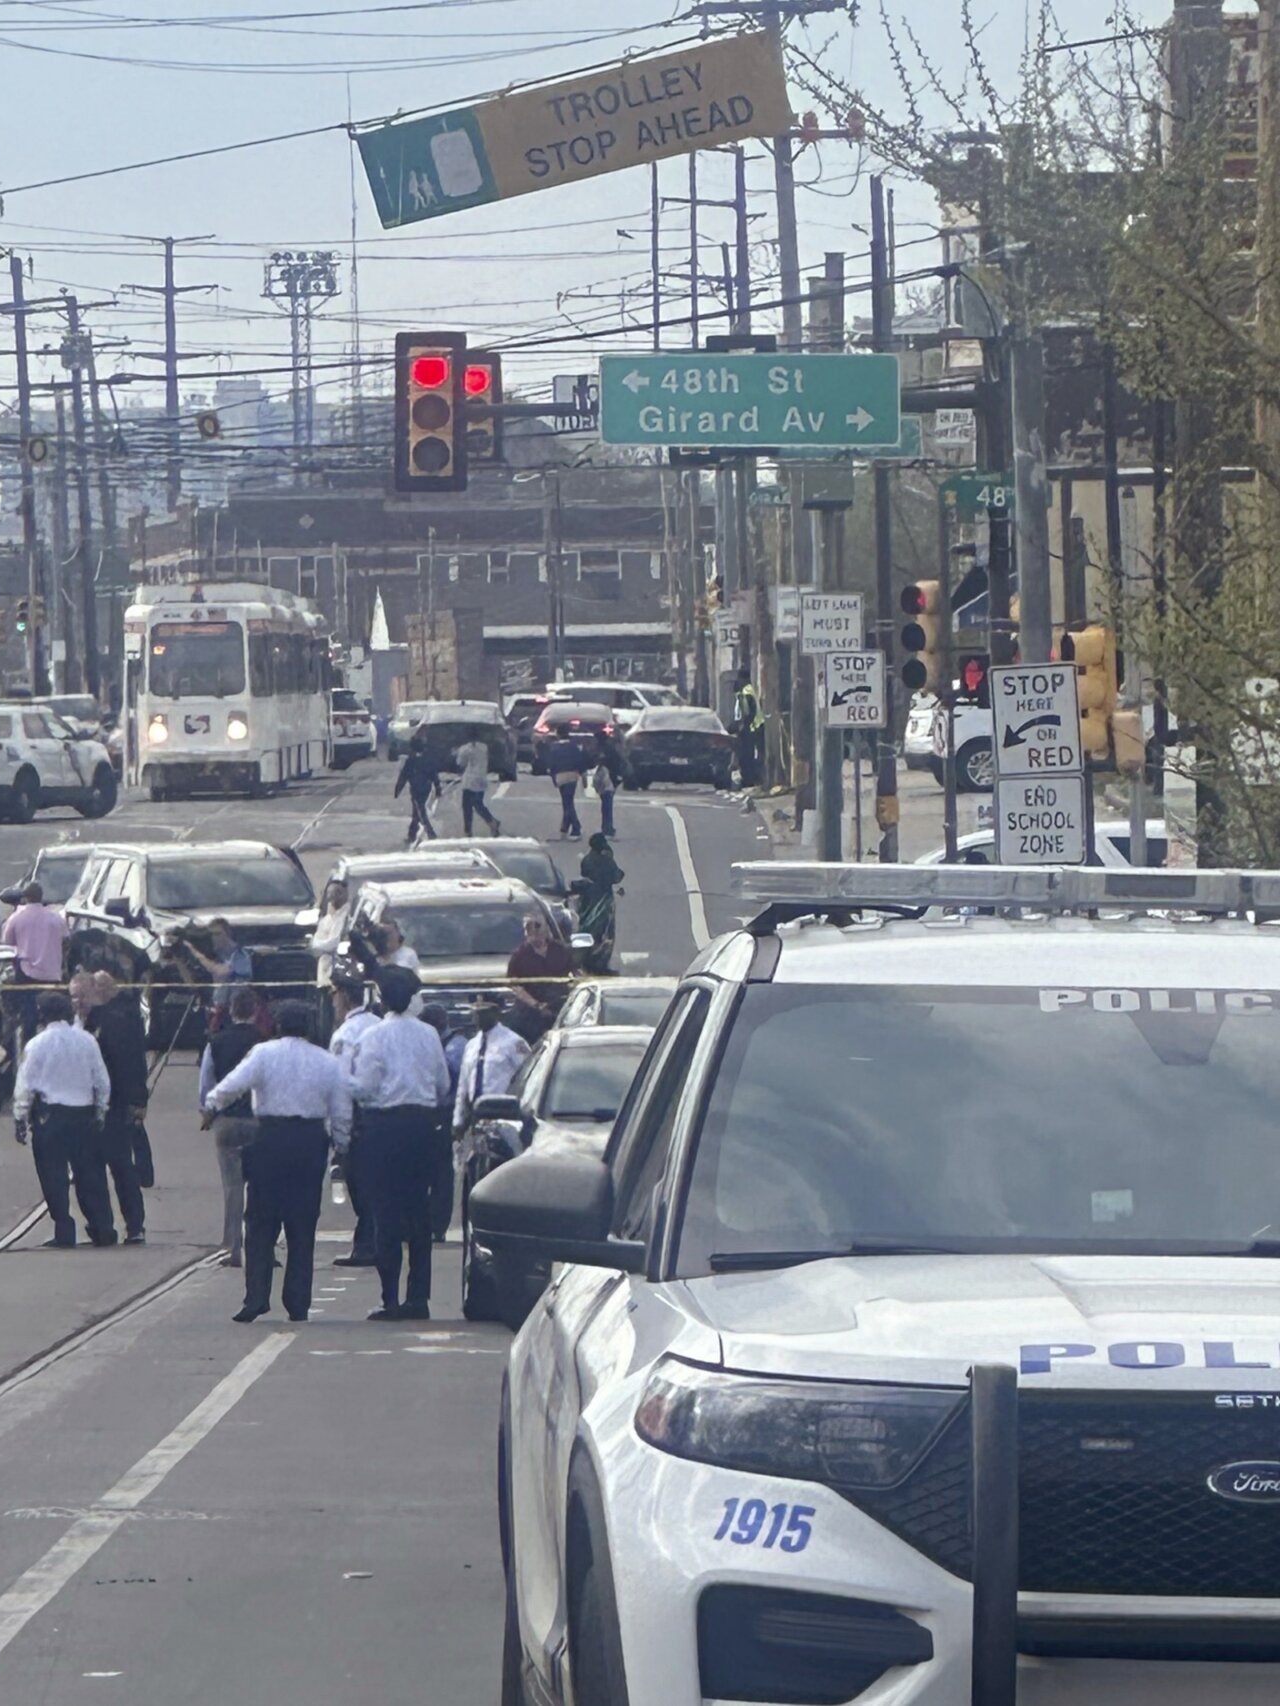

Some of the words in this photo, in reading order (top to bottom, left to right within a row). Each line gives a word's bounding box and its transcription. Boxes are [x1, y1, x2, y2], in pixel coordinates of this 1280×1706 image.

[546, 61, 704, 127] TROLLEY
[524, 133, 618, 179] STOP
[637, 94, 755, 150] AHEAD
[660, 367, 740, 394] 48th
[767, 365, 806, 395] St
[638, 405, 759, 434] Girard
[781, 406, 826, 433] Av
[812, 618, 850, 631] MUST
[832, 656, 877, 671] STOP
[1003, 673, 1065, 697] STOP
[846, 705, 879, 722] RED
[1016, 697, 1054, 713] HERE
[1028, 746, 1074, 768] RED
[1007, 811, 1075, 831] SCHOOL
[1019, 834, 1065, 855] ZONE
[713, 1497, 817, 1553] 1915
